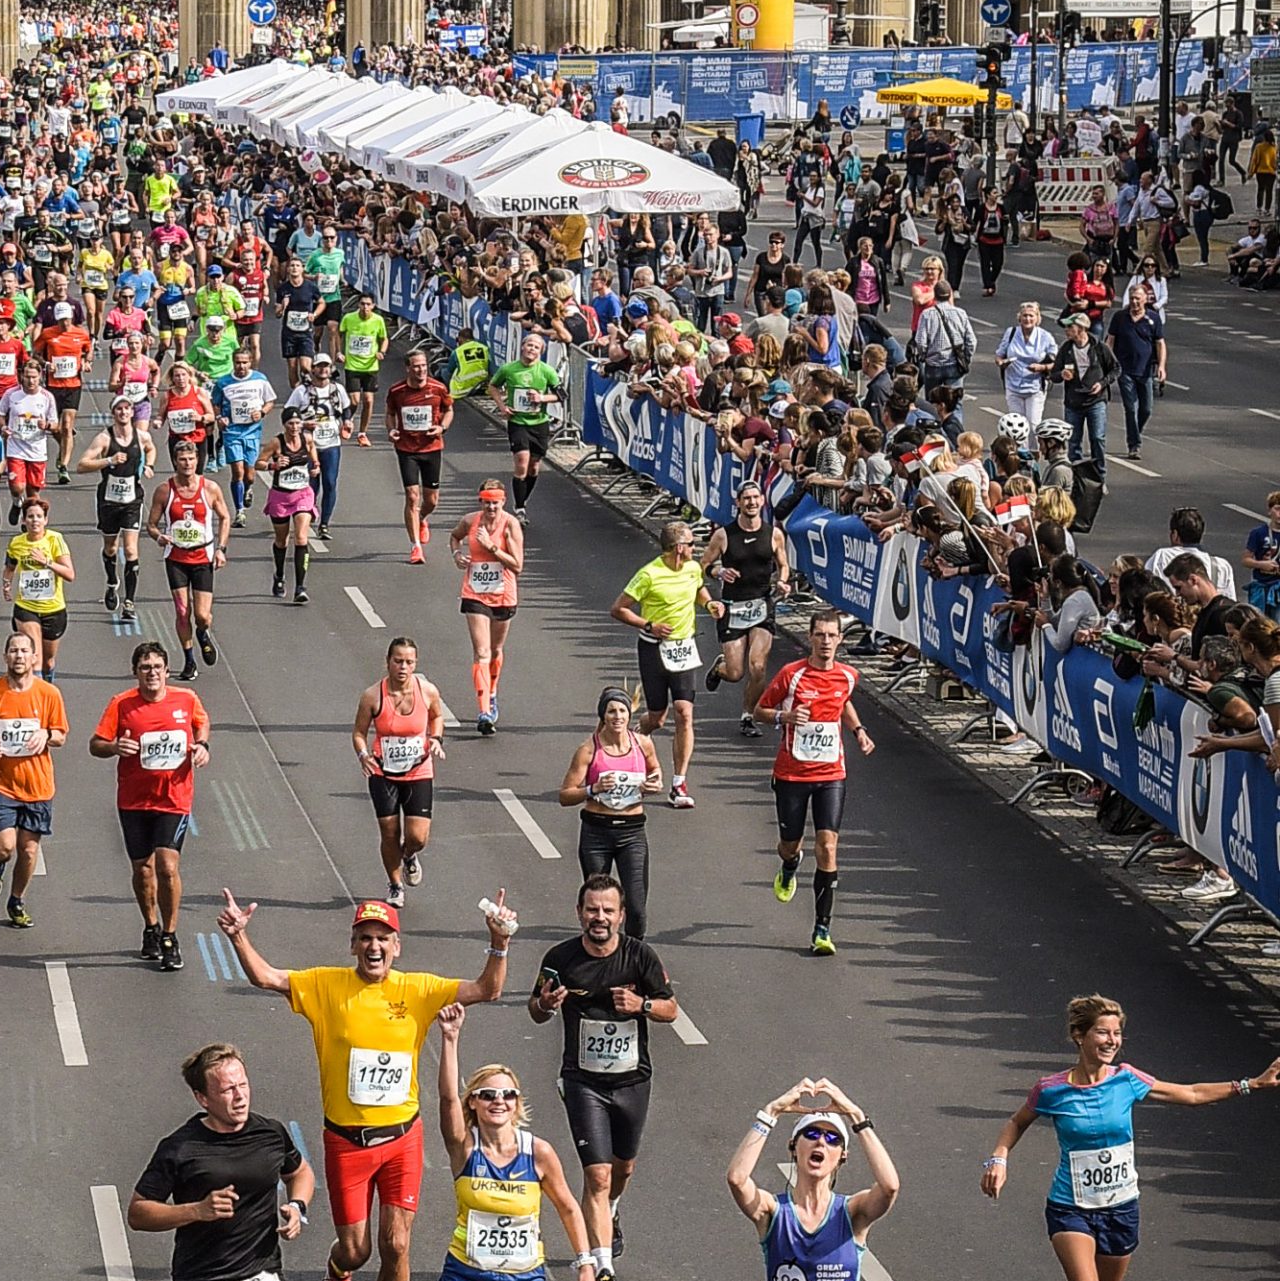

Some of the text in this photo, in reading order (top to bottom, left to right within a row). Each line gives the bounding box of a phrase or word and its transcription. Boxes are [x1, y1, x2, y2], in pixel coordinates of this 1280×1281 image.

[921, 95, 968, 104] HOTDOGS
[501, 196, 580, 212] ERDINGER
[642, 190, 703, 208] Weißbier
[842, 534, 863, 567] BMW
[472, 569, 499, 582] 56023
[842, 561, 863, 587] BERLIN
[24, 578, 50, 590] 34958
[801, 734, 834, 747] 11702
[1053, 712, 1082, 753] adidas
[147, 742, 181, 755] 66114
[1137, 744, 1161, 778] BERLIN
[610, 783, 638, 799] 2577
[1138, 771, 1173, 816] MARATHON
[1228, 833, 1258, 882] adidas
[587, 1036, 630, 1053] 23195
[359, 1066, 403, 1084] 11739
[1083, 1161, 1129, 1187] 30876
[471, 1180, 526, 1195] UKRAINE
[477, 1229, 528, 1248] 25535
[816, 1271, 850, 1279] ORMOND
